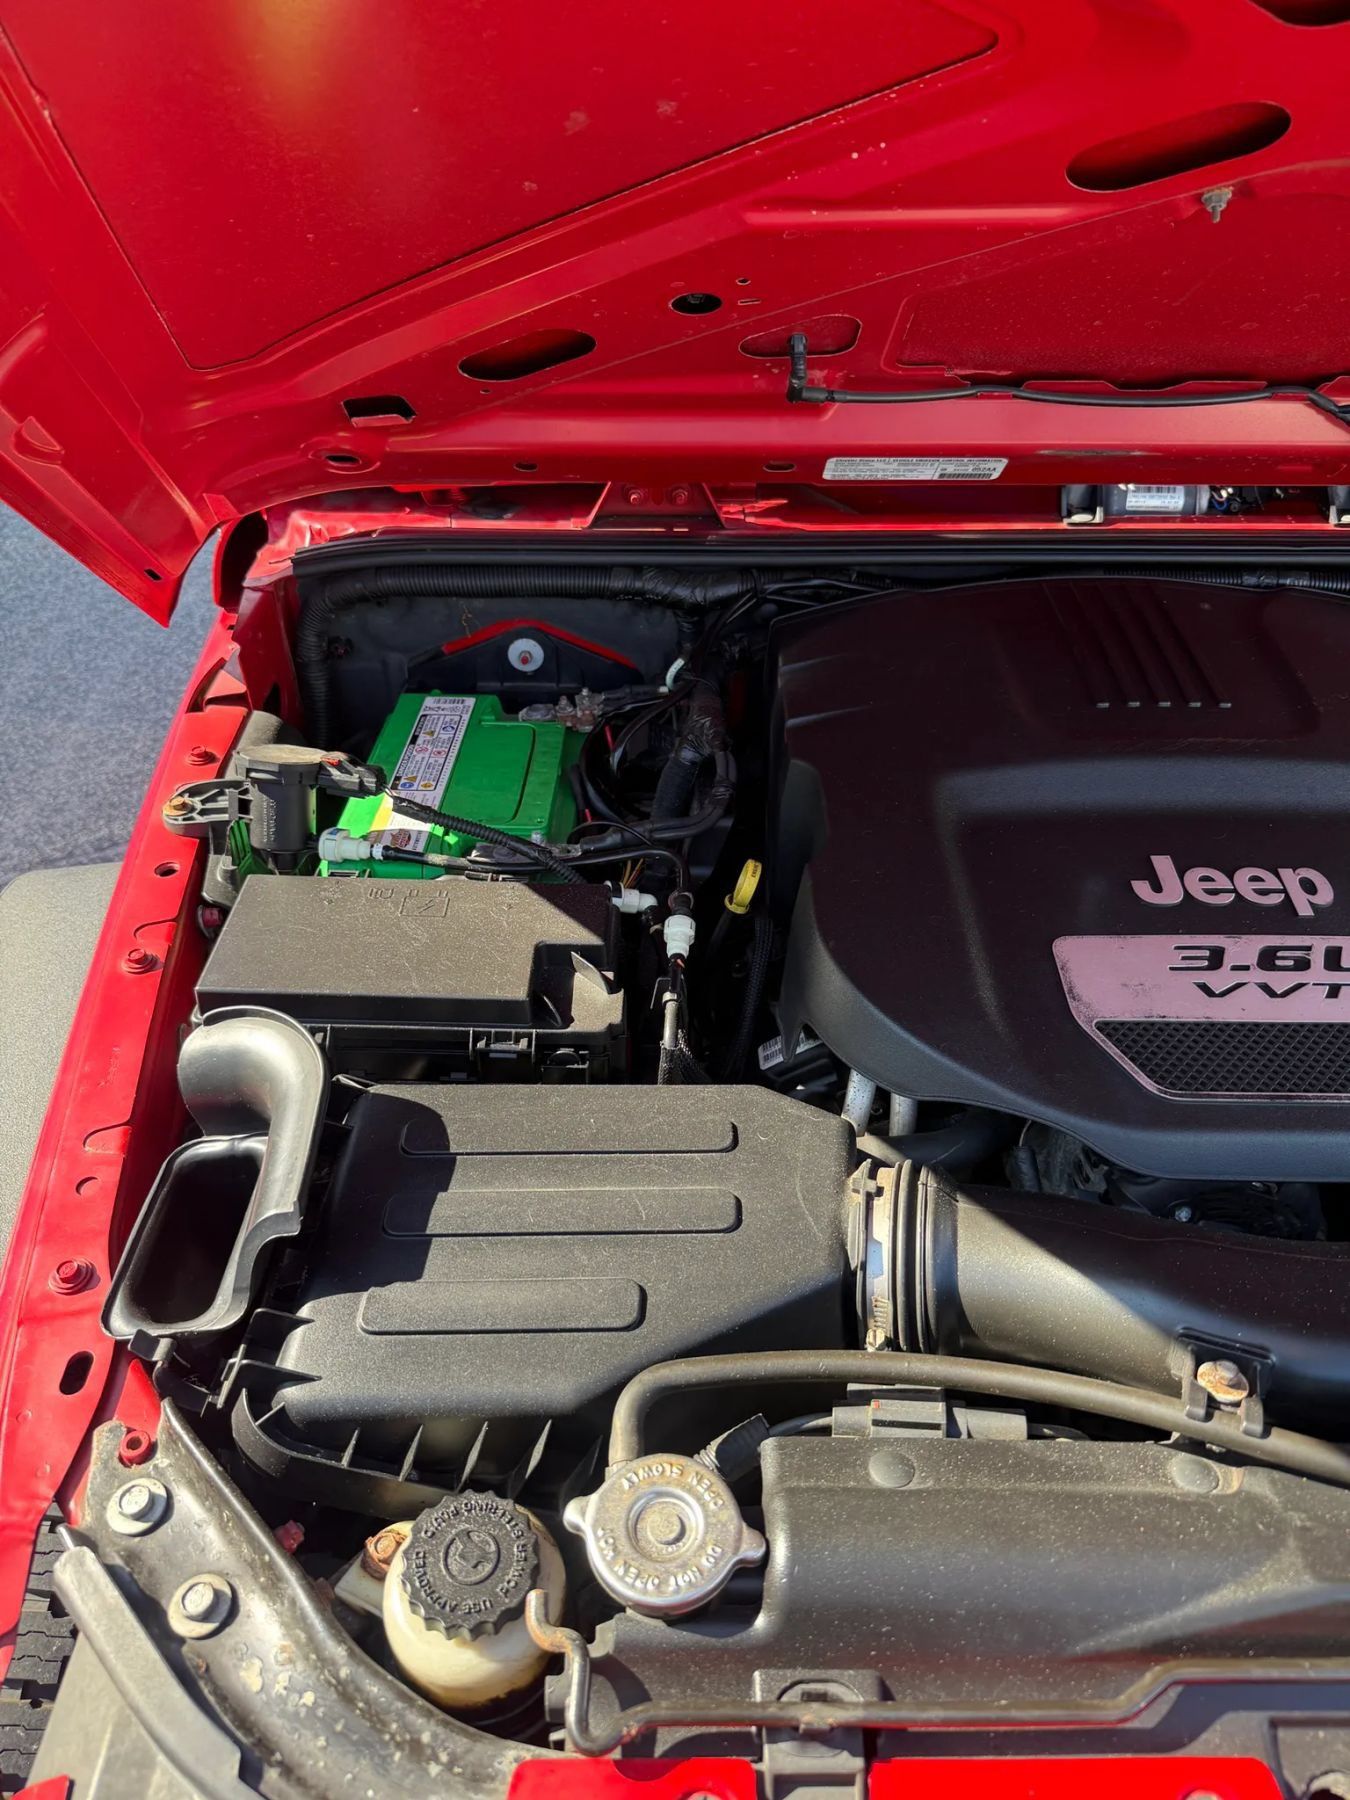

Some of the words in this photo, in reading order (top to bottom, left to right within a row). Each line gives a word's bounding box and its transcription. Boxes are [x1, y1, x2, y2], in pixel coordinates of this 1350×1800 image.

[1130, 855, 1335, 917] Jeep
[1192, 981, 1350, 999] VVT
[621, 1462, 684, 1490] SLOWLY
[688, 1471, 725, 1509] OPEN
[701, 1545, 723, 1567] DO
[414, 1550, 459, 1613] APPROVED
[613, 1560, 660, 1591] OPEN
[668, 1565, 702, 1591] NOT
[462, 1598, 494, 1615] USE
